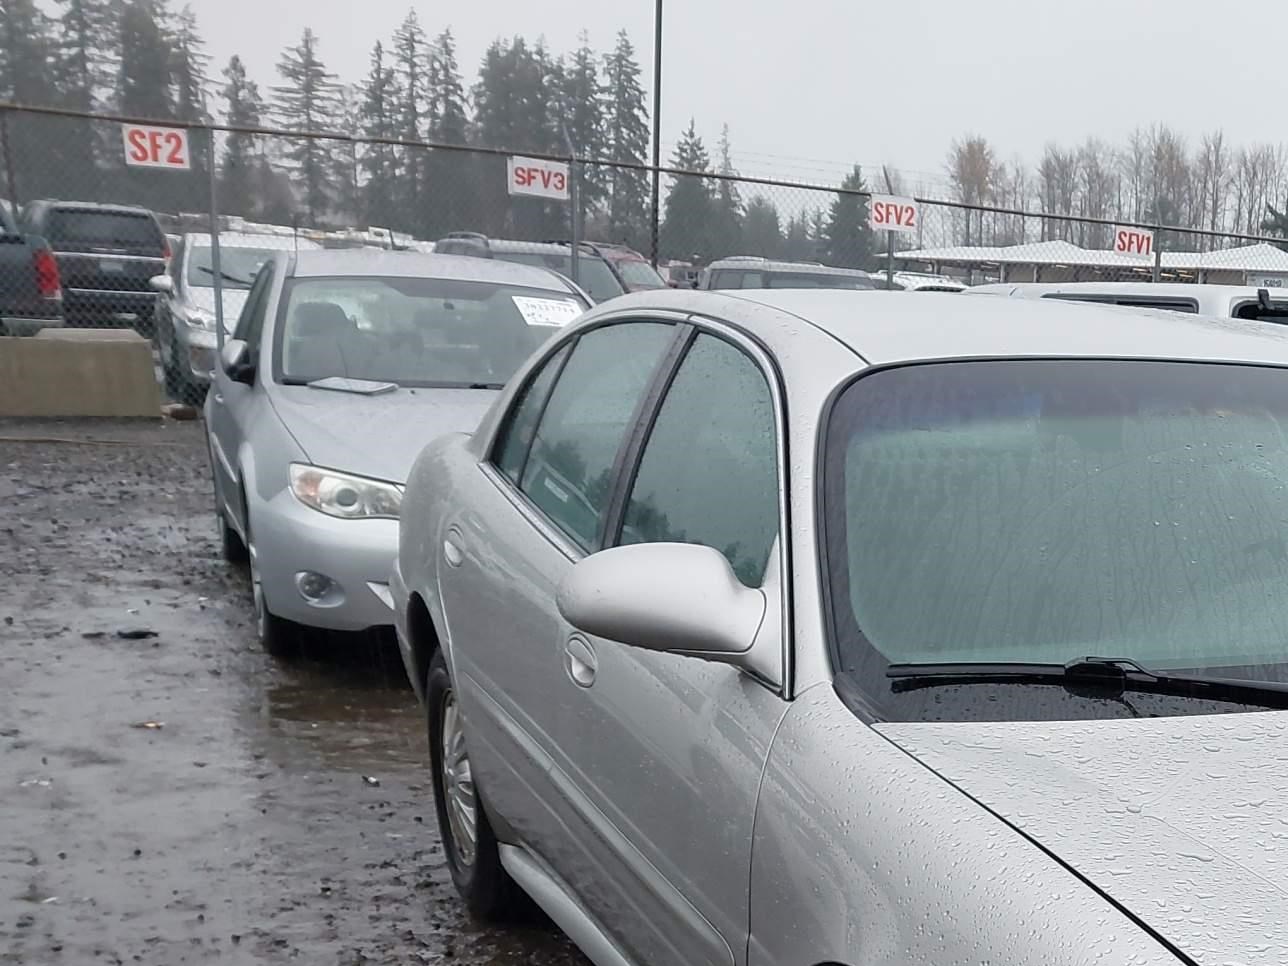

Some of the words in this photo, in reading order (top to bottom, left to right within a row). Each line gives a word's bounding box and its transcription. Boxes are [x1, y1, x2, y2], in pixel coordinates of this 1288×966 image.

[129, 129, 185, 164] SF2
[514, 168, 566, 191] SFV3
[873, 203, 915, 226] SFV2
[1117, 230, 1151, 255] SFV1
